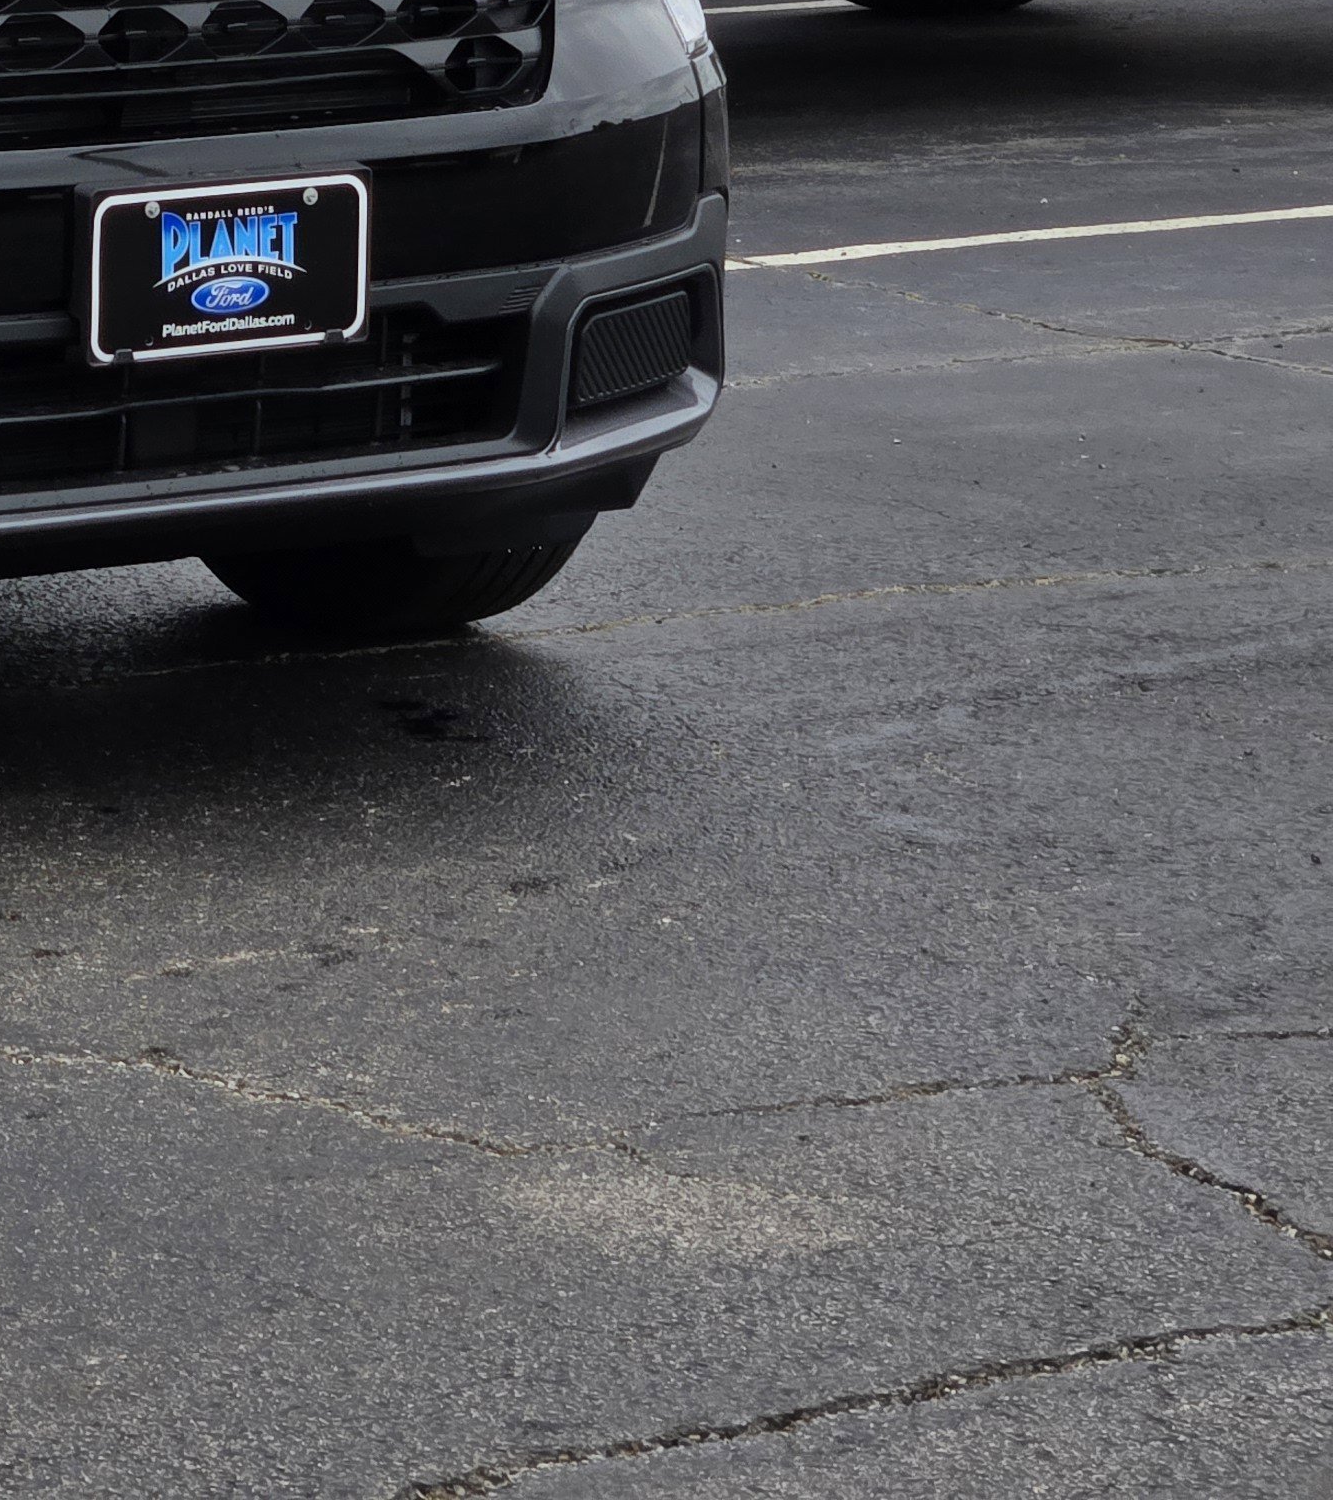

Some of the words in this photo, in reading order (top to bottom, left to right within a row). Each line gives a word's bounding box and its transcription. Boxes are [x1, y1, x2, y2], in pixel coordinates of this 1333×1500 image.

[186, 209, 233, 221] RANDALL
[161, 211, 299, 280] PLANET
[167, 266, 216, 293] DALLAS
[221, 263, 253, 275] LOVE
[258, 264, 293, 280] FIELD
[205, 281, 255, 307] Ford
[162, 313, 295, 338] PlanetFordDallas.com
